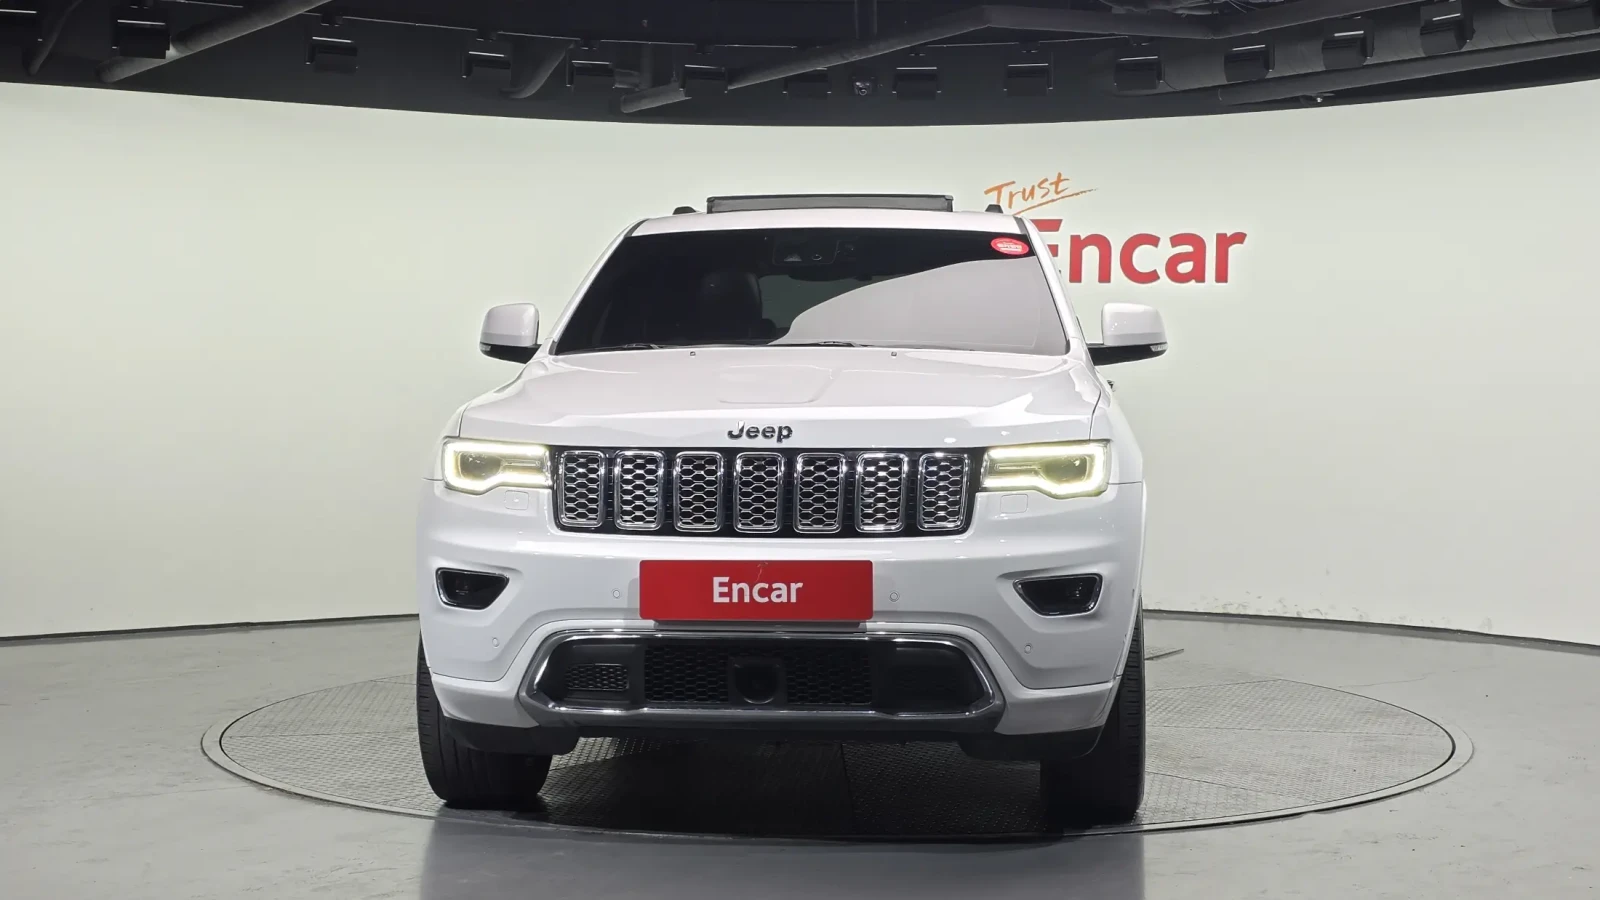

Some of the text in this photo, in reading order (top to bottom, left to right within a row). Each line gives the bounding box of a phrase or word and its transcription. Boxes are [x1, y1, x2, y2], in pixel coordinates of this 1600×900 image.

[983, 171, 1070, 209] Trust
[727, 421, 793, 443] Jeep
[712, 576, 804, 604] Encar
